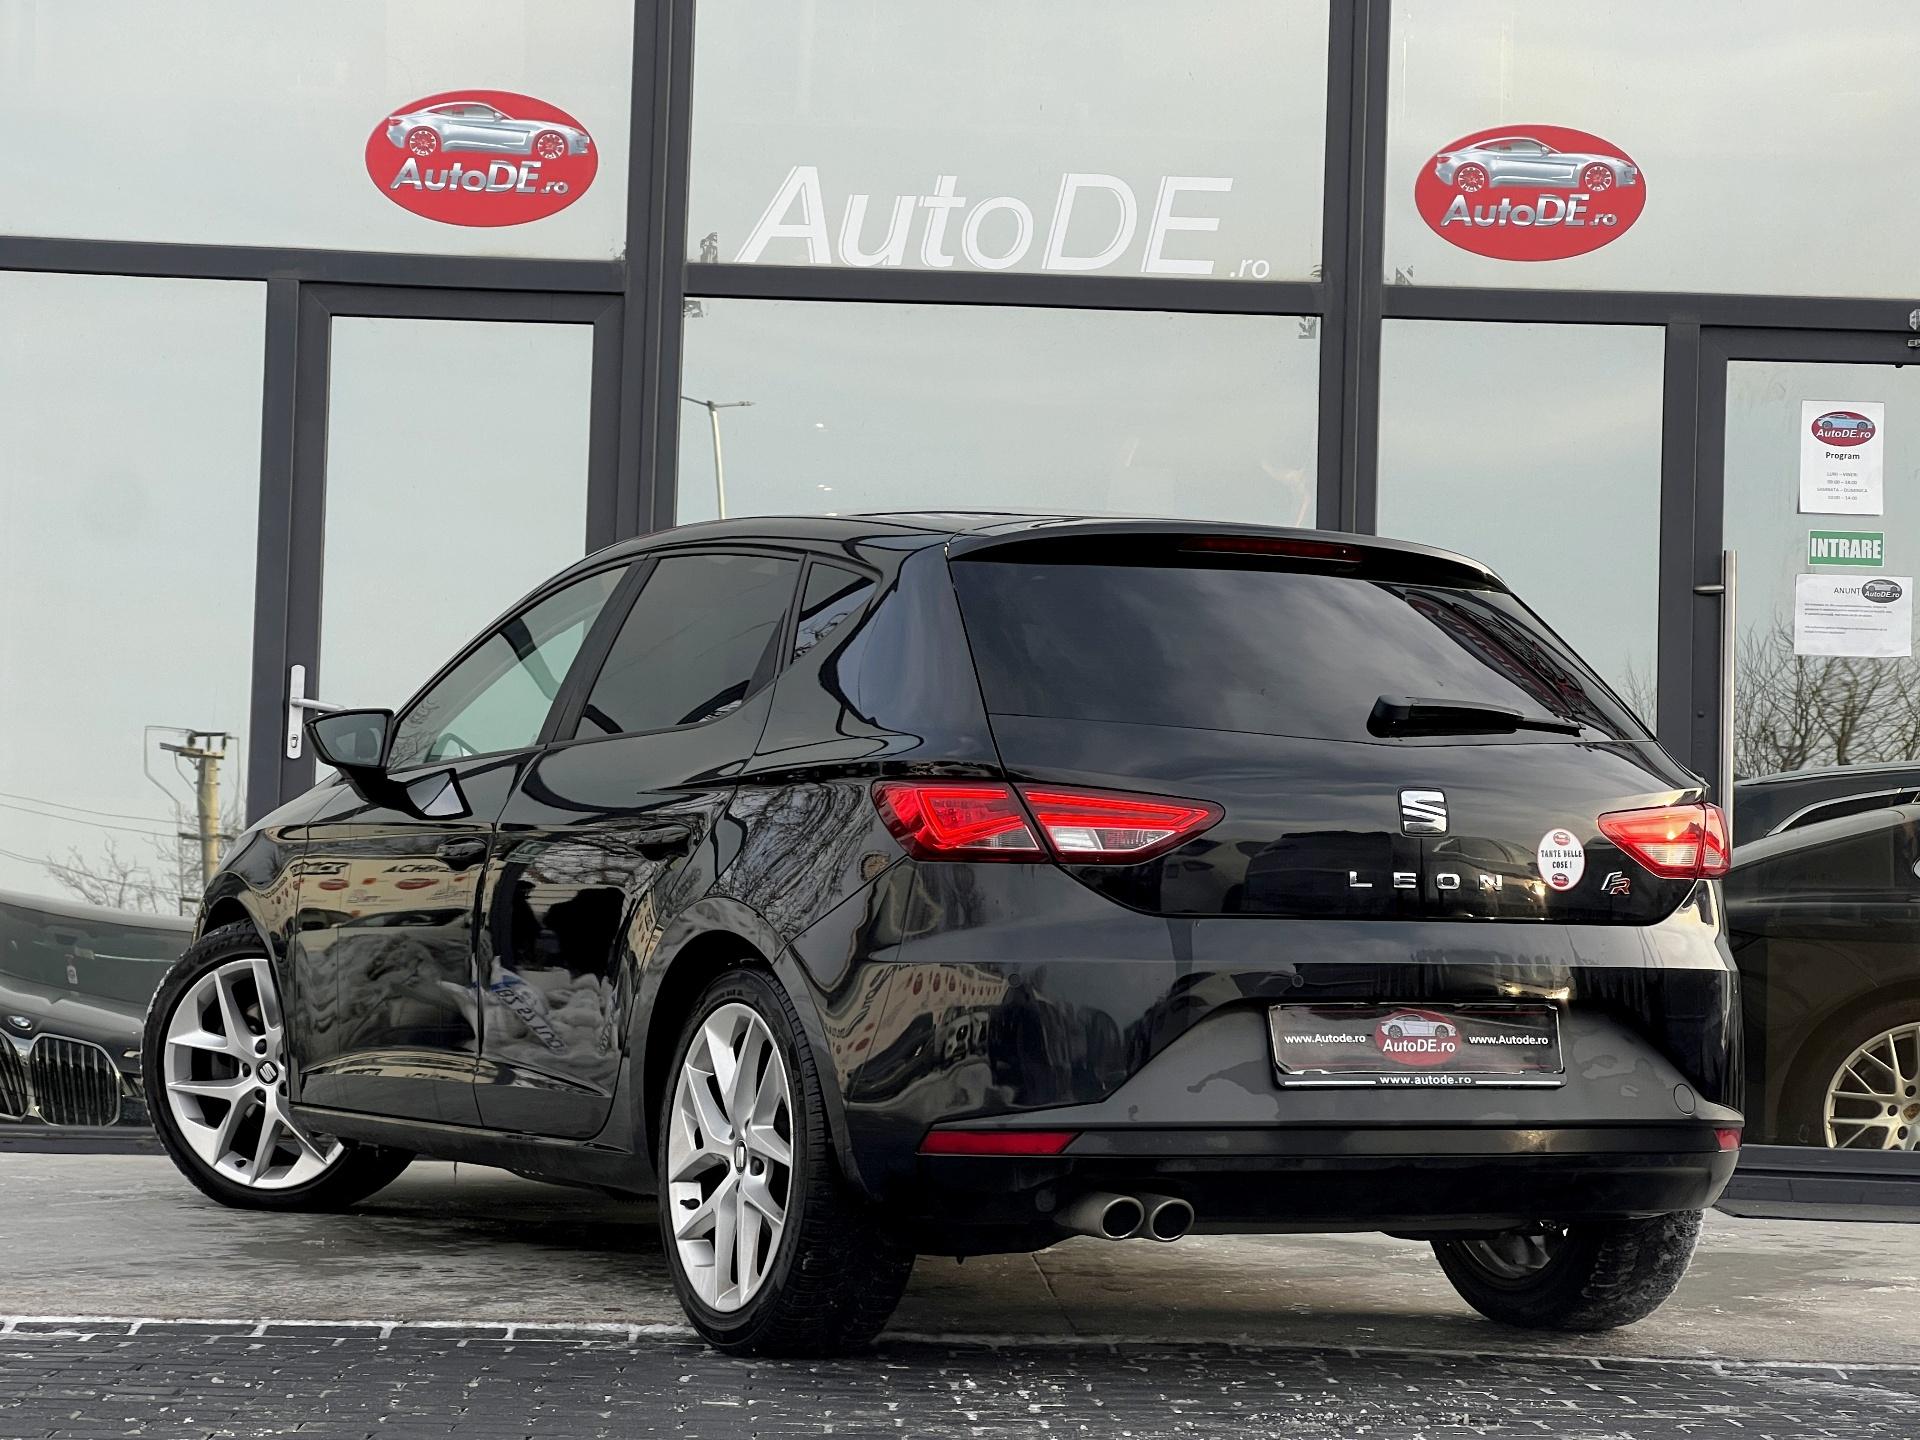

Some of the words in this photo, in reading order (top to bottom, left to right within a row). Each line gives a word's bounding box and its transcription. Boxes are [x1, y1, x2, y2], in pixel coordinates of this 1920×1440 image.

[1816, 429, 1871, 438] AutoDE.ro
[1825, 451, 1861, 461] Program
[1811, 538, 1881, 559] INTRARE
[1864, 590, 1900, 598] AutoDE.ro
[1563, 850, 1583, 858] BELLE
[1552, 861, 1569, 869] COSE
[1349, 871, 1503, 891] LEON
[1284, 1033, 1366, 1044] www.Autode.ro
[1469, 1035, 1549, 1045] www.Autode.ro
[1383, 1039, 1456, 1053] AutoDE.ro
[1379, 1075, 1472, 1085] www.autode.ro
